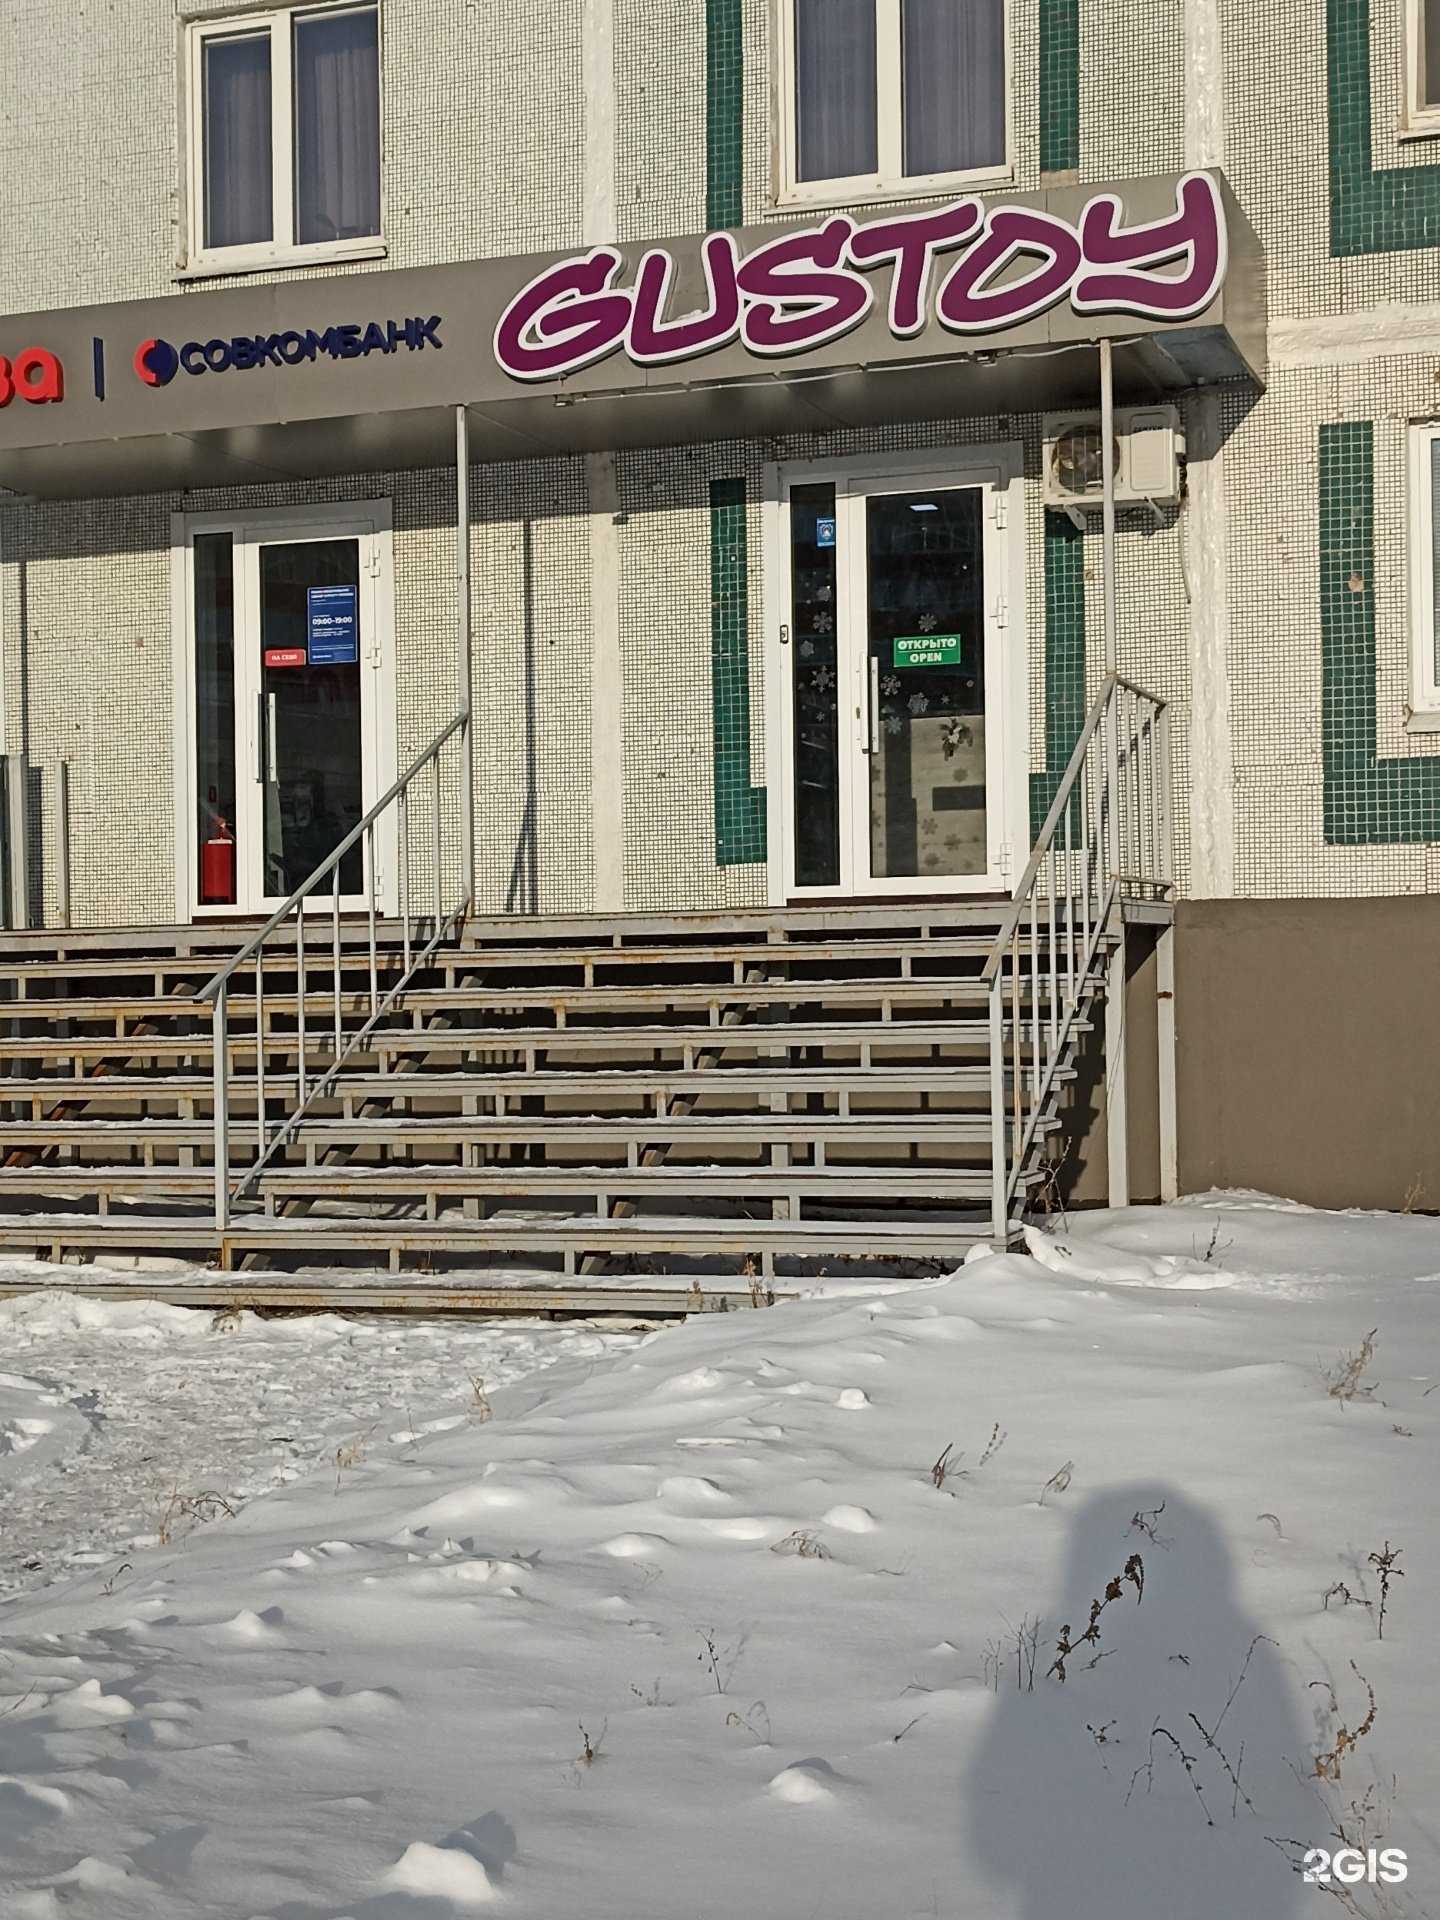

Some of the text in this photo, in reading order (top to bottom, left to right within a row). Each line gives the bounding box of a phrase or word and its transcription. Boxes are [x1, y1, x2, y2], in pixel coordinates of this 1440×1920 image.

[493, 170, 1228, 380] GUSTOY
[179, 315, 443, 375] СОВКОМБАНК
[897, 637, 957, 651] ОТКРЫТО
[910, 652, 943, 664] OPEN
